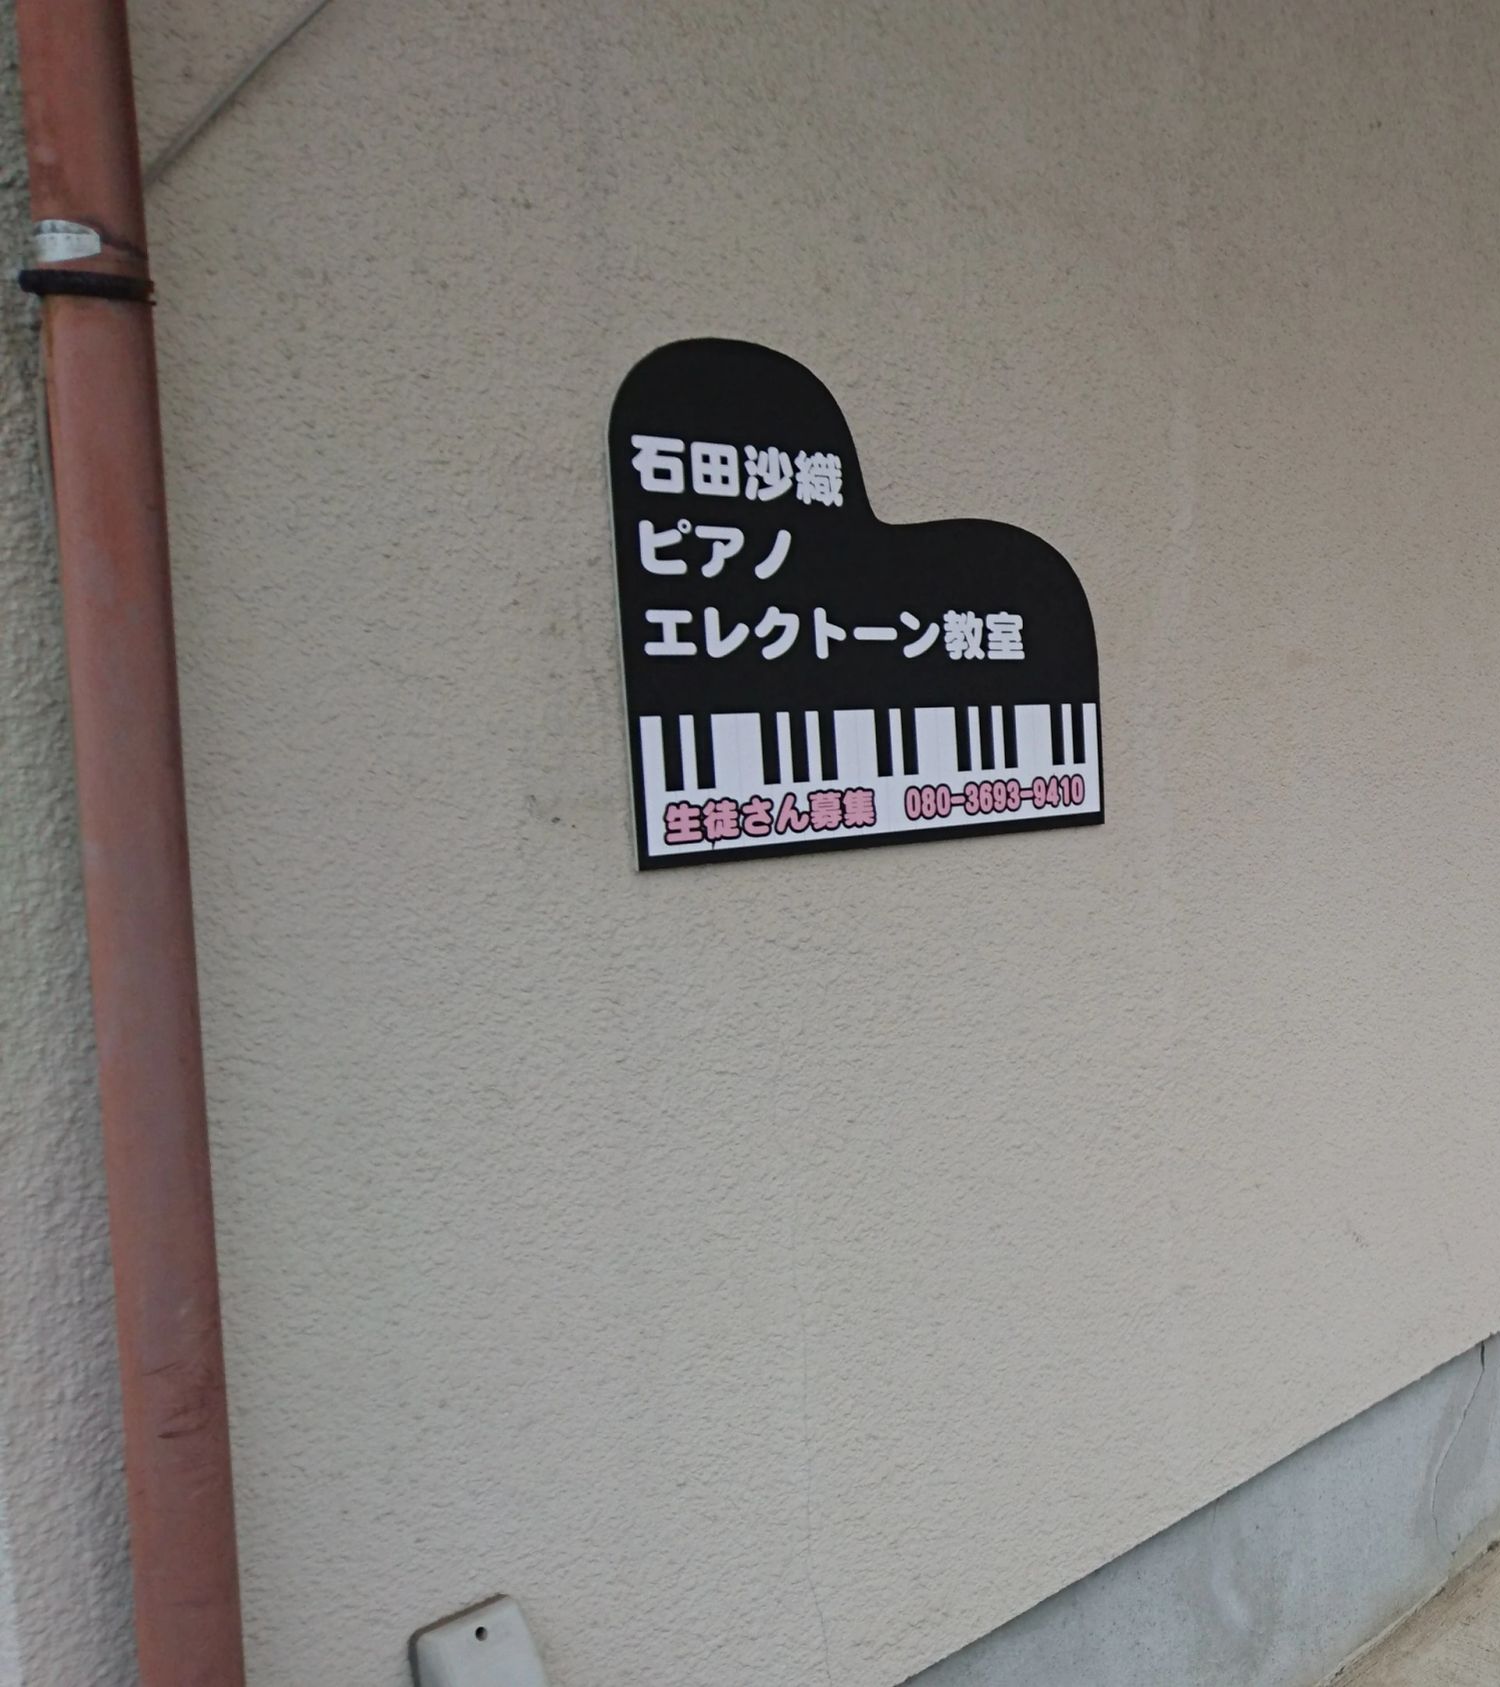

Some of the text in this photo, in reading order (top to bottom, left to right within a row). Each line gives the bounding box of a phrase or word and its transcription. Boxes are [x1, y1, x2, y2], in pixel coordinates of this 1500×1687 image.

[630, 433, 845, 508] 石田沙織
[637, 517, 792, 581] ピアノ
[643, 605, 1026, 661] エレクトーン教室
[664, 774, 1085, 848] 生徒さん募集 080-3693-9410
